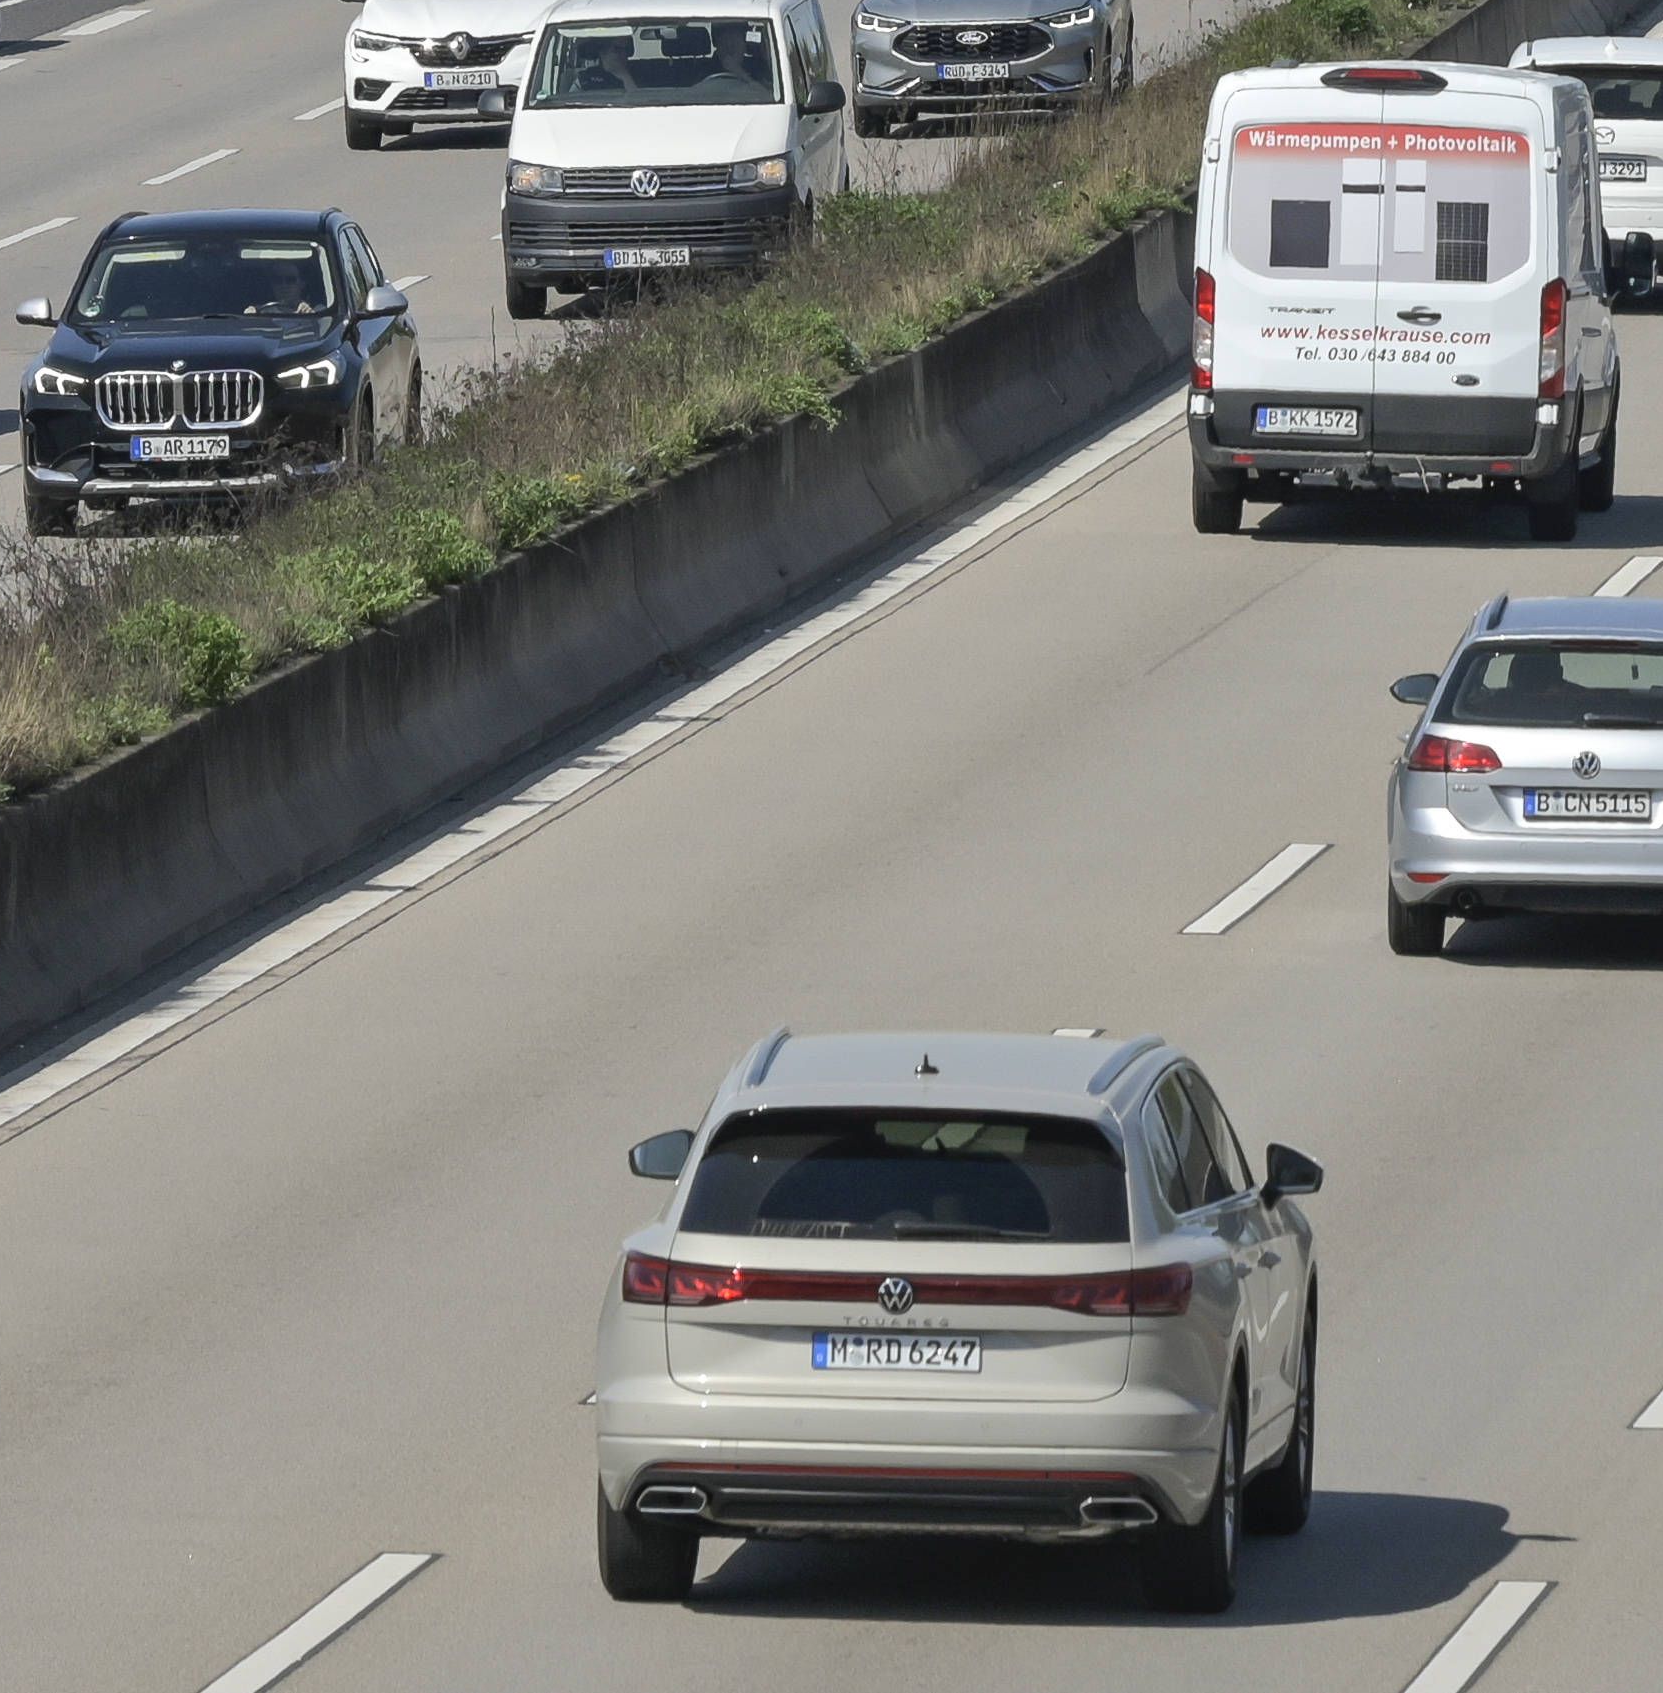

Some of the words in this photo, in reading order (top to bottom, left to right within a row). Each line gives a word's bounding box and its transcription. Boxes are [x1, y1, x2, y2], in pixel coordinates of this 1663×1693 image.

[436, 74, 445, 86] B
[462, 73, 491, 85] 8210
[1248, 129, 1382, 154] Wärmepumpen
[1404, 134, 1517, 155] Photovoltaik
[1609, 162, 1642, 177] 3291
[1259, 325, 1492, 346] www.kesselkrause.com
[1295, 346, 1323, 362] Tel.
[1327, 347, 1357, 362] 030
[1400, 349, 1431, 365] 884
[1436, 351, 1456, 366] 00
[1268, 409, 1279, 426] B
[1289, 410, 1310, 427] KK
[1314, 410, 1356, 429] 1572
[142, 439, 153, 456] B
[163, 438, 183, 455] AR
[189, 437, 228, 454] 1179
[1536, 791, 1550, 812] B
[1563, 791, 1592, 813] CN
[1595, 792, 1647, 814] 5115
[842, 1316, 950, 1328] TOUAREG
[831, 1338, 851, 1364] M
[865, 1339, 901, 1365] RD
[907, 1339, 978, 1366] 6247
